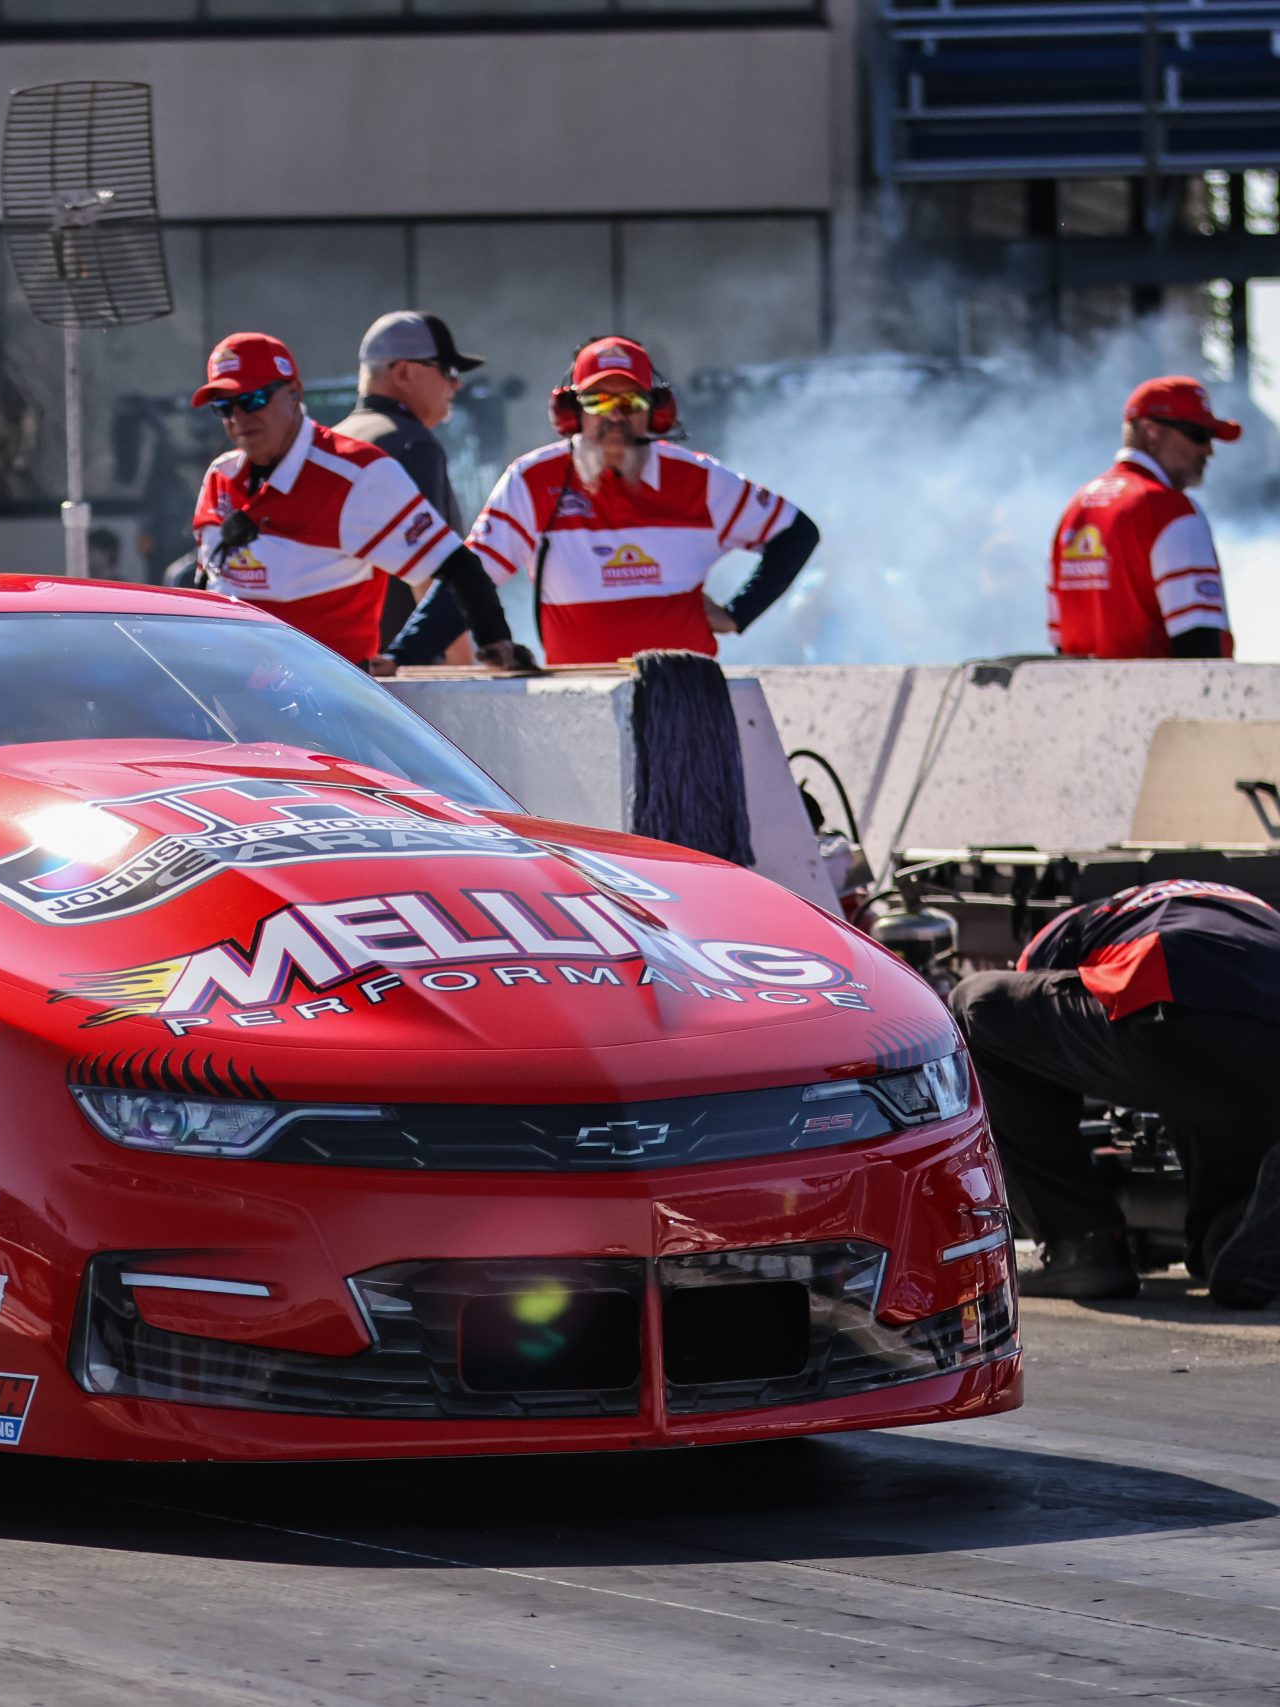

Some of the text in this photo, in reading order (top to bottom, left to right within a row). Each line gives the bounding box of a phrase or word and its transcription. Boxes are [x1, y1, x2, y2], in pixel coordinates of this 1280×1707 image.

[47, 826, 286, 912] JOHNSON'S
[158, 890, 840, 1016] MELLING
[164, 965, 875, 1037] PERFORMANCE
[802, 1113, 854, 1133] SS
